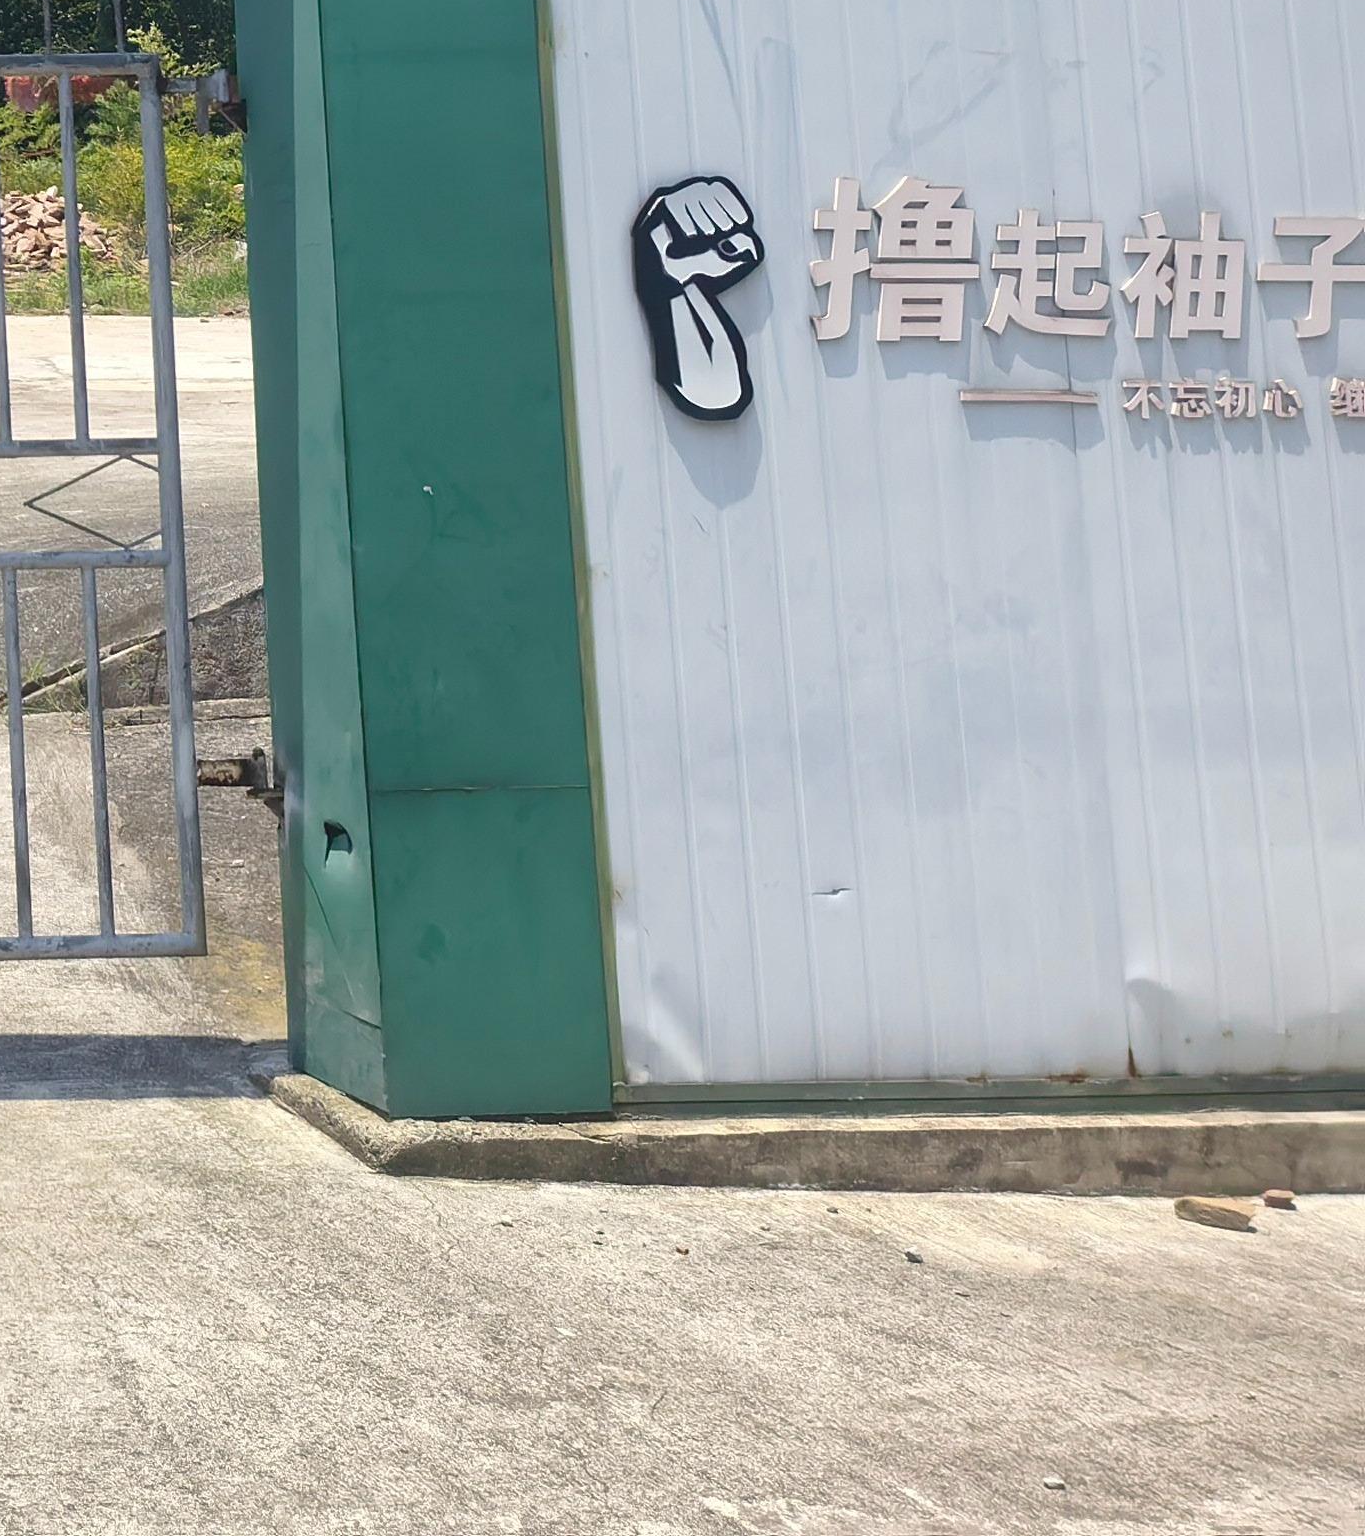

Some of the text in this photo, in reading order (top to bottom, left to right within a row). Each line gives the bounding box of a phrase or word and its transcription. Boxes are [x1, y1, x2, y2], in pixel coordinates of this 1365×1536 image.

[809, 175, 1365, 343] 撸起袖子
[1122, 377, 1304, 419] 不忘初心
